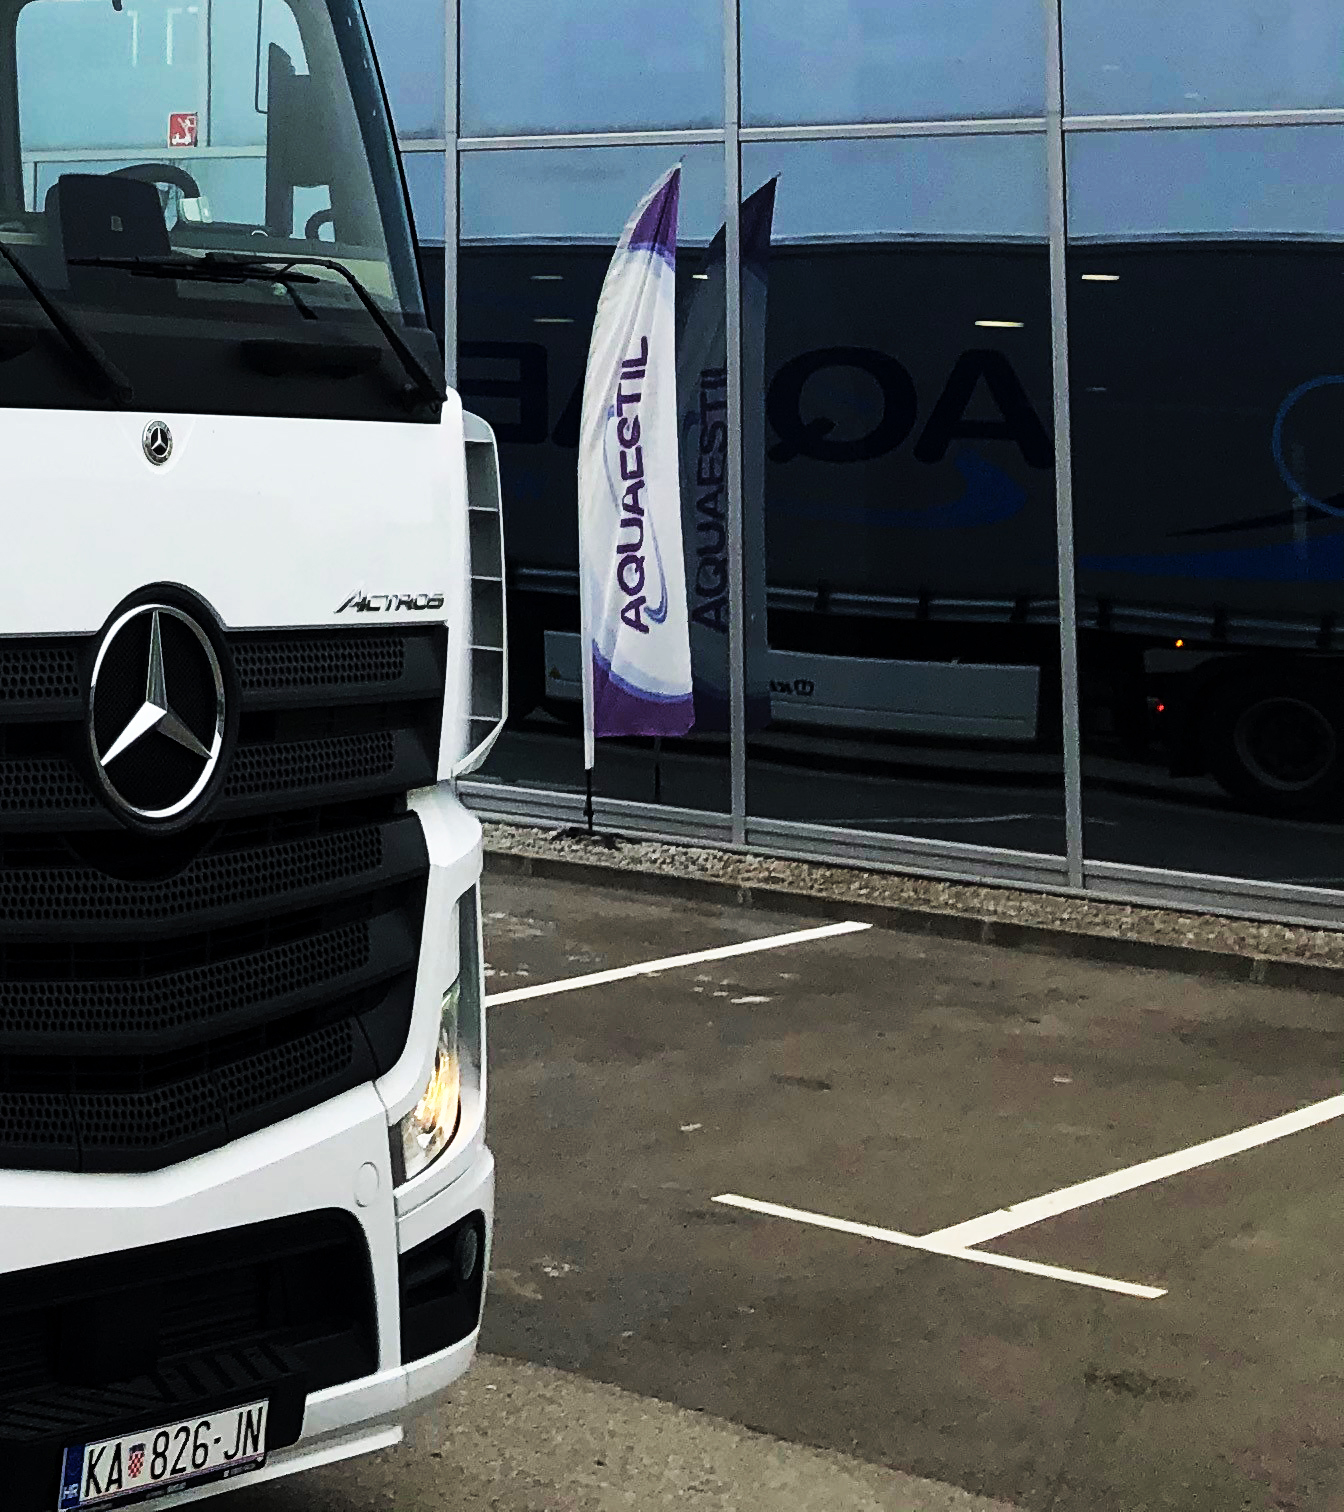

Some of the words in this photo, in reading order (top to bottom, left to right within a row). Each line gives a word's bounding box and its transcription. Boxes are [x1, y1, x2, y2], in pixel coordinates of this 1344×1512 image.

[616, 336, 649, 635] AQUAESTIL
[333, 586, 445, 614] ACTROS
[84, 1441, 123, 1498] KA
[150, 1406, 264, 1481] 826-JN
